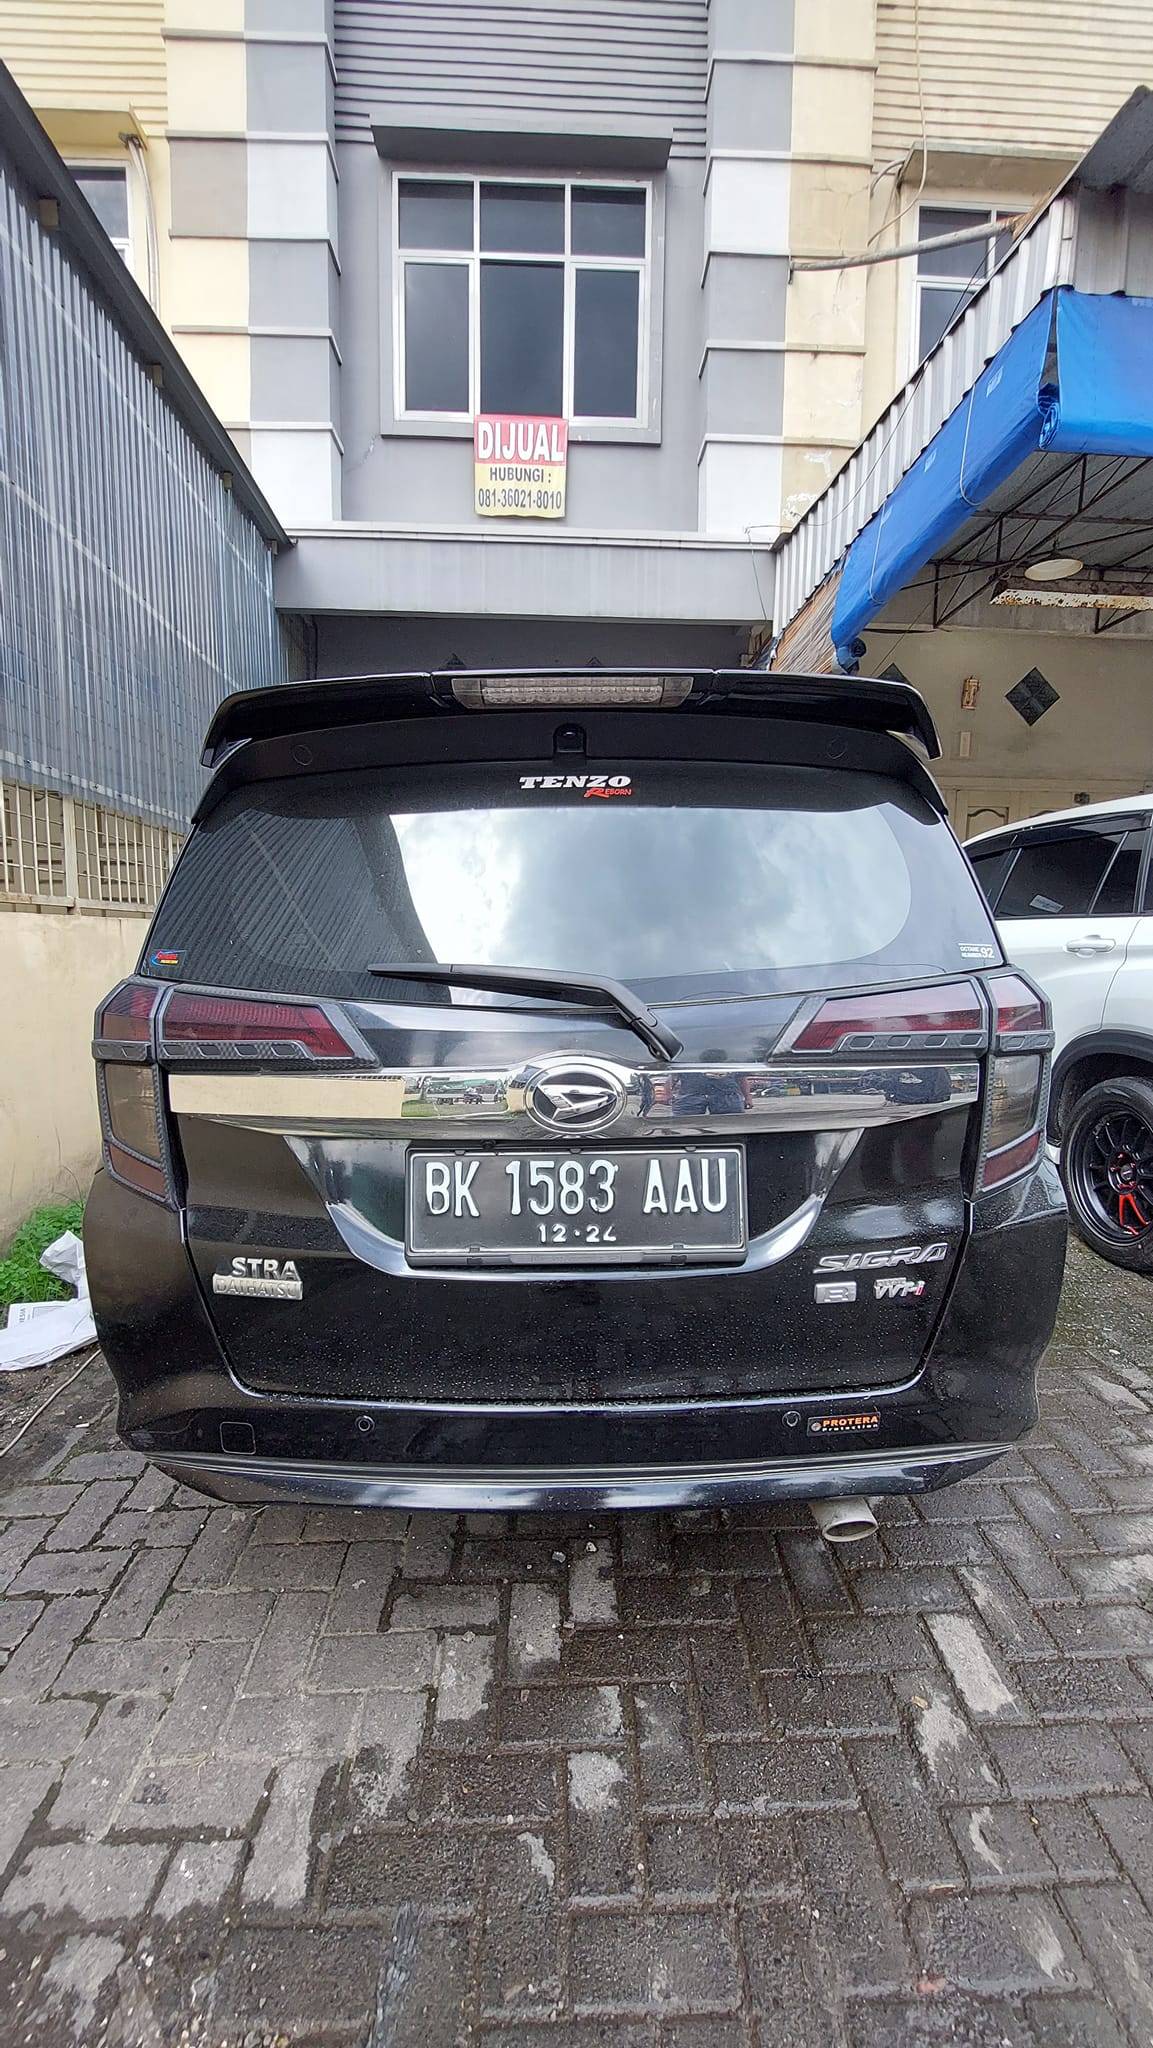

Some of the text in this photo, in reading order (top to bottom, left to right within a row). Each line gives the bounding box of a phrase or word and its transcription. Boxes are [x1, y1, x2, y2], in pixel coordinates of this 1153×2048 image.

[478, 421, 564, 462] DIJUAL
[490, 466, 544, 483] HUBUNGI
[478, 488, 562, 510] 081-36021-8010
[519, 775, 631, 789] TENZO
[426, 1157, 728, 1217] BK 1583 AAU
[232, 1257, 301, 1282] STRA
[813, 1242, 948, 1274] SIGRA
[822, 1415, 879, 1428] PROTERA
